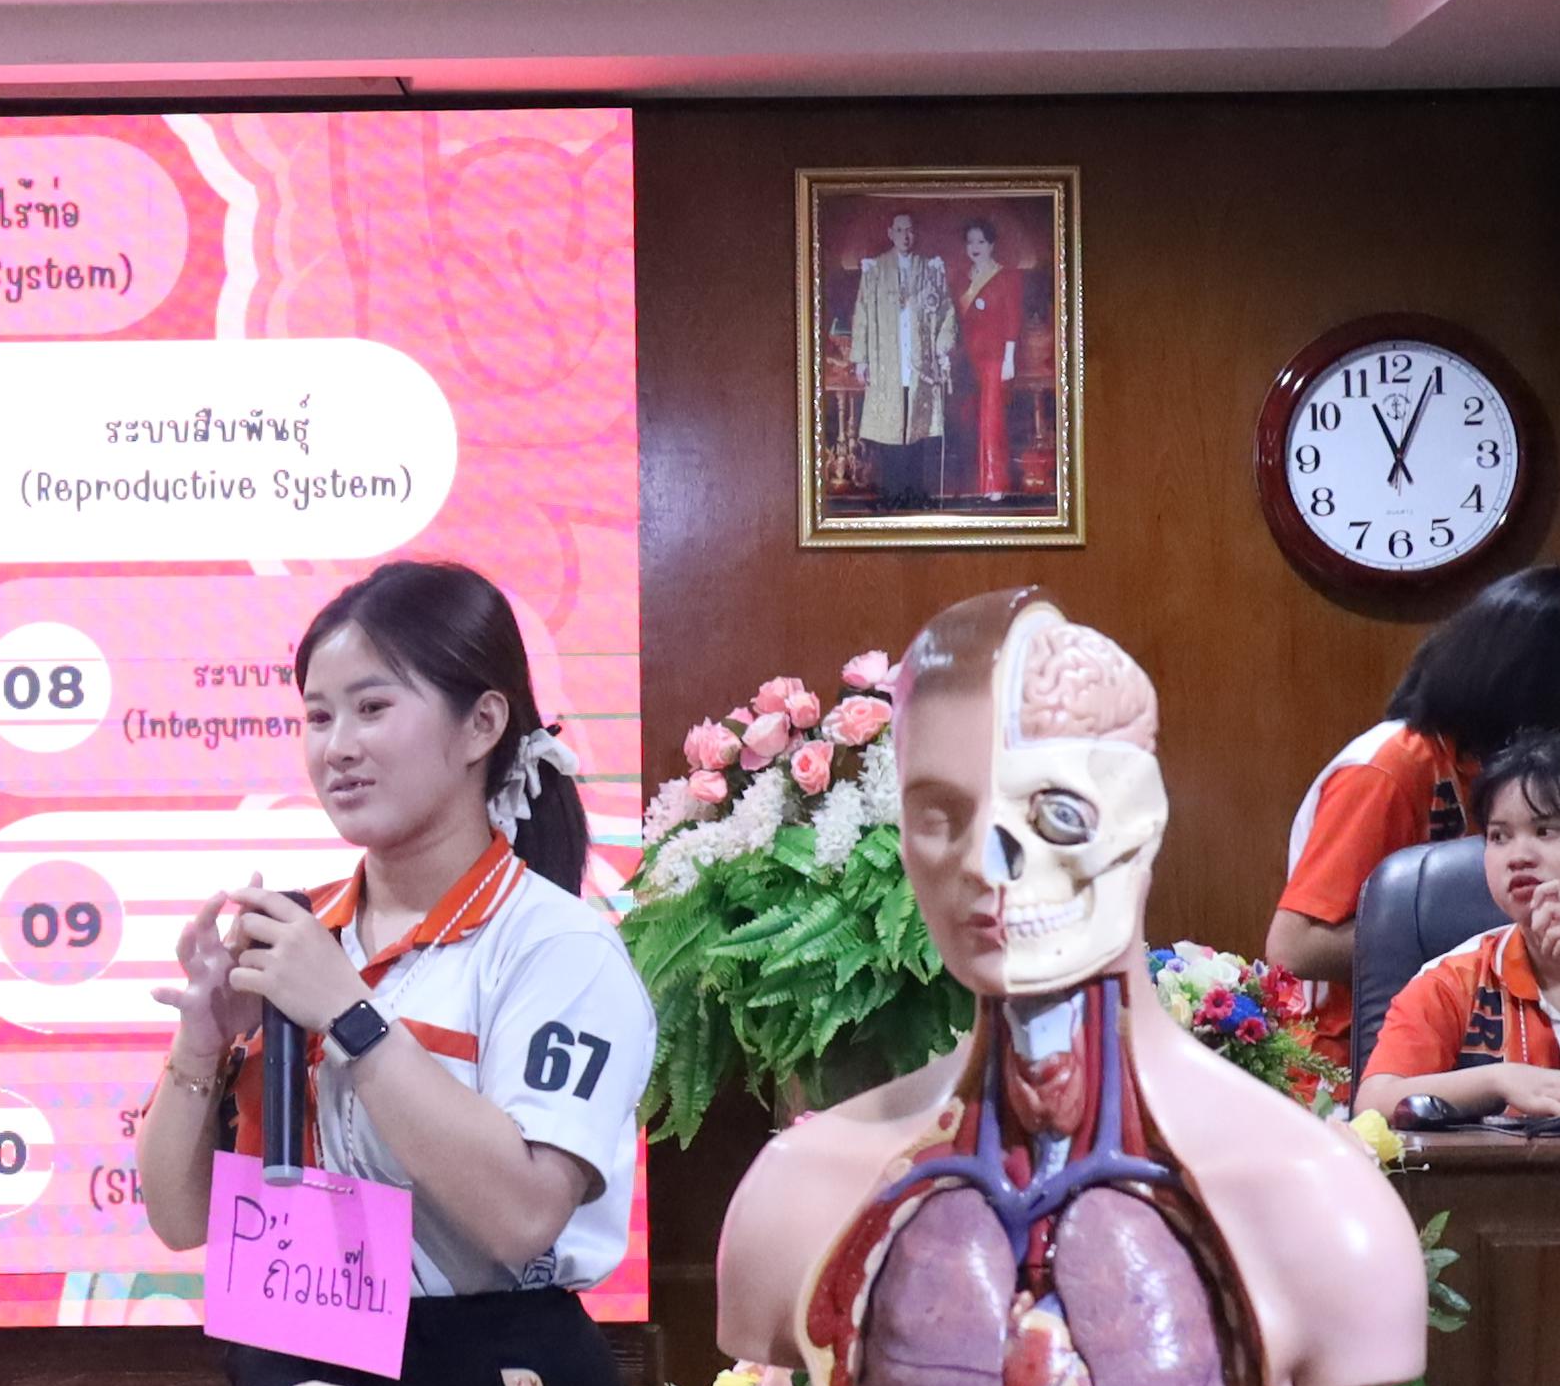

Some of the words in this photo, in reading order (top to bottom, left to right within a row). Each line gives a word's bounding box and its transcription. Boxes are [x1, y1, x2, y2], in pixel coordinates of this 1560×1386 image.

[1376, 354, 1412, 383] 12
[1433, 366, 1446, 395] 1
[1342, 369, 1370, 398] 11
[106, 394, 310, 455] ระบบสืบพันธุ์
[1309, 402, 1341, 431] 10
[1463, 397, 1484, 426] 2
[1295, 445, 1320, 473] 9
[1476, 439, 1500, 469] 3
[22, 470, 256, 511] (Reproductive
[274, 466, 411, 510] System)
[1310, 487, 1335, 516] 8
[1460, 484, 1484, 513] 4
[1348, 521, 1372, 550] 7
[1388, 530, 1414, 558] 6
[1429, 517, 1454, 547] 5
[4, 666, 84, 709] 08
[122, 708, 306, 750] (Integumen
[21, 902, 101, 947] 09
[523, 1020, 613, 1102] 67
